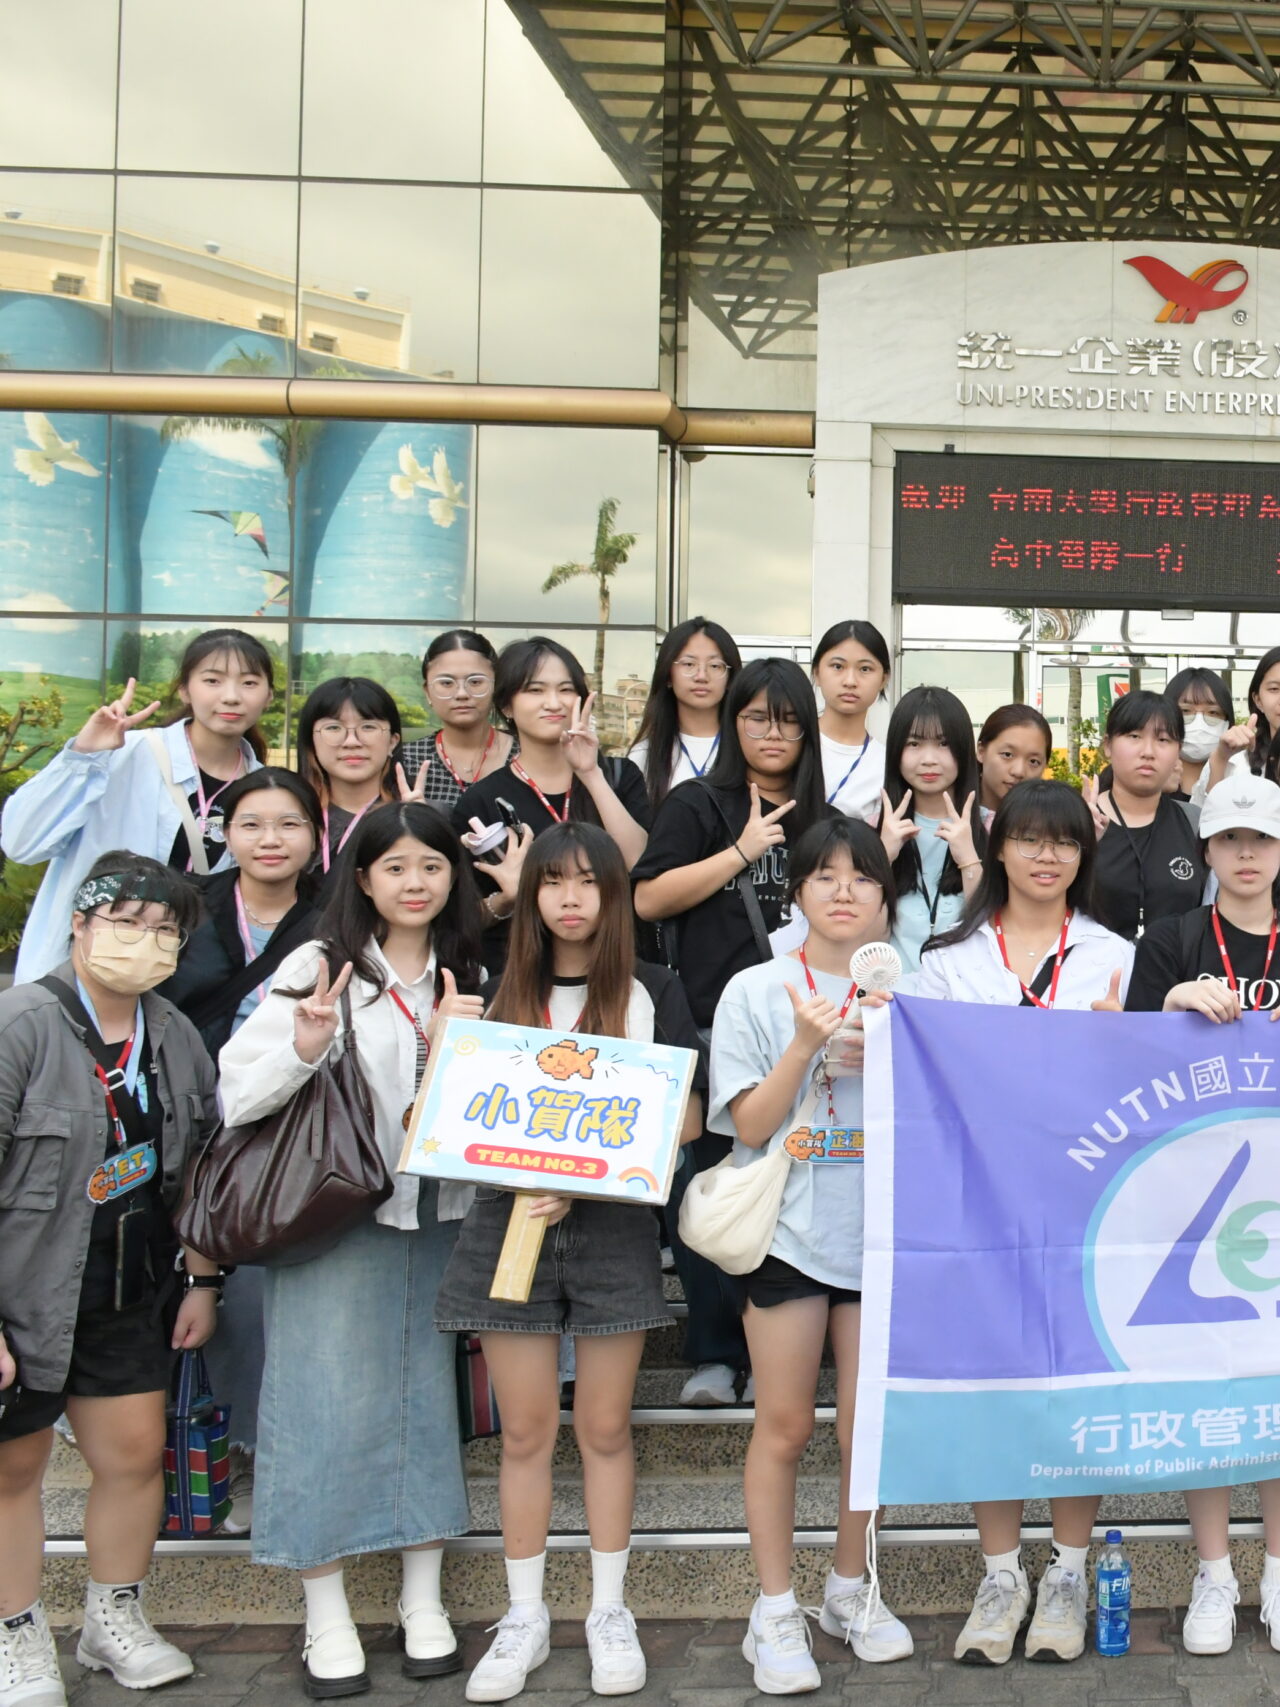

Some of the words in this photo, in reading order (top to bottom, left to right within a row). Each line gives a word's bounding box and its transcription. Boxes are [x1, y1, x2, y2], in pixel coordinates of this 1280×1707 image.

[956, 382, 1155, 412] UNI-PRESIDENT
[464, 1082, 641, 1149] 小賀隊
[476, 1149, 540, 1168] TEAM
[543, 1157, 598, 1175] NO.3
[1030, 1463, 1130, 1479] Department
[1134, 1460, 1151, 1476] of
[1155, 1456, 1204, 1474] Public
